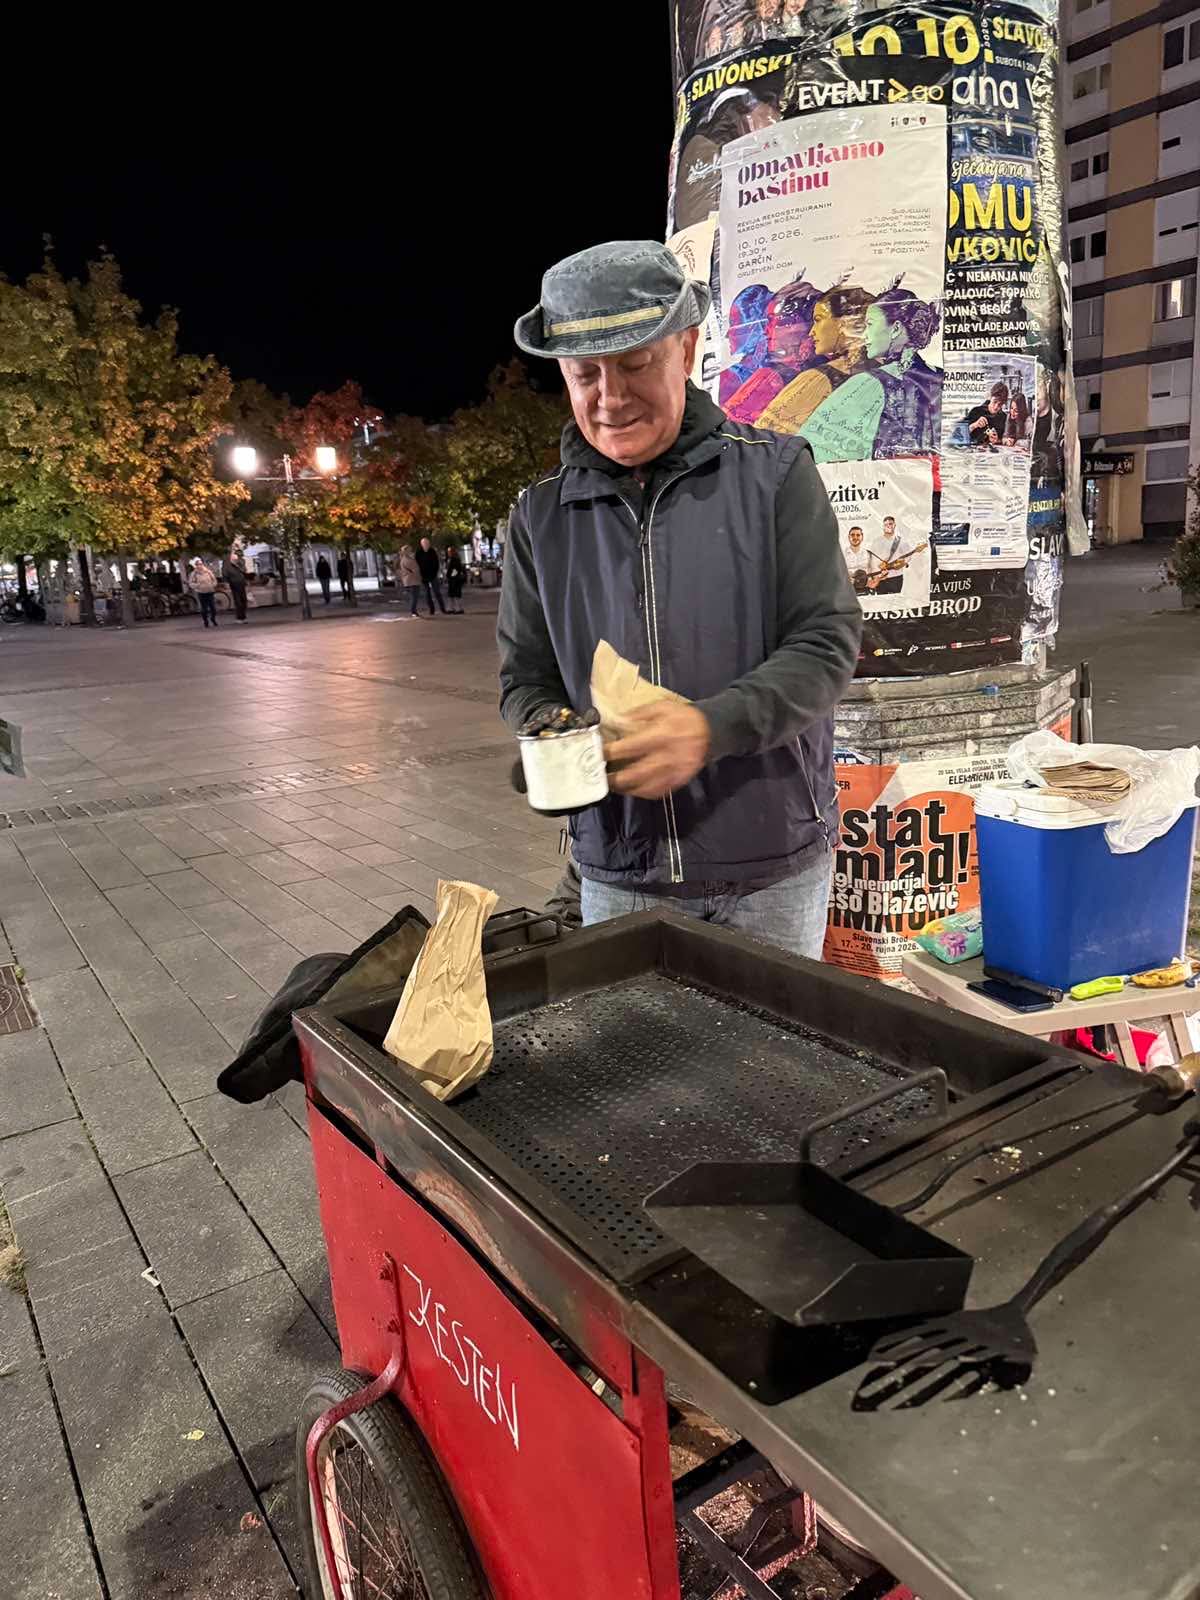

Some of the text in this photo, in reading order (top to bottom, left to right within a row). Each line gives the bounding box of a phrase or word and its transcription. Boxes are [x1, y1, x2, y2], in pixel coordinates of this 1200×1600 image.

[994, 56, 1022, 68] SUBOTA
[691, 54, 793, 101] SLAVONSKI
[798, 80, 885, 110] EVENT
[738, 171, 830, 208] baštinu
[771, 228, 804, 242] 2026.
[738, 254, 773, 270] GARČIN
[966, 271, 1018, 282] NEMANJA
[945, 324, 970, 334] STAR
[972, 322, 1001, 332] VLADE
[943, 371, 985, 382] RADIONICE
[943, 578, 972, 594] VIJUŠ
[928, 596, 981, 617] BROD
[841, 801, 946, 849] stat
[855, 871, 925, 892] memorijal
[868, 885, 960, 916] Blažević
[852, 932, 908, 945] Slavonski Brod
[875, 946, 896, 954] rujna
[897, 942, 919, 952] 2026.
